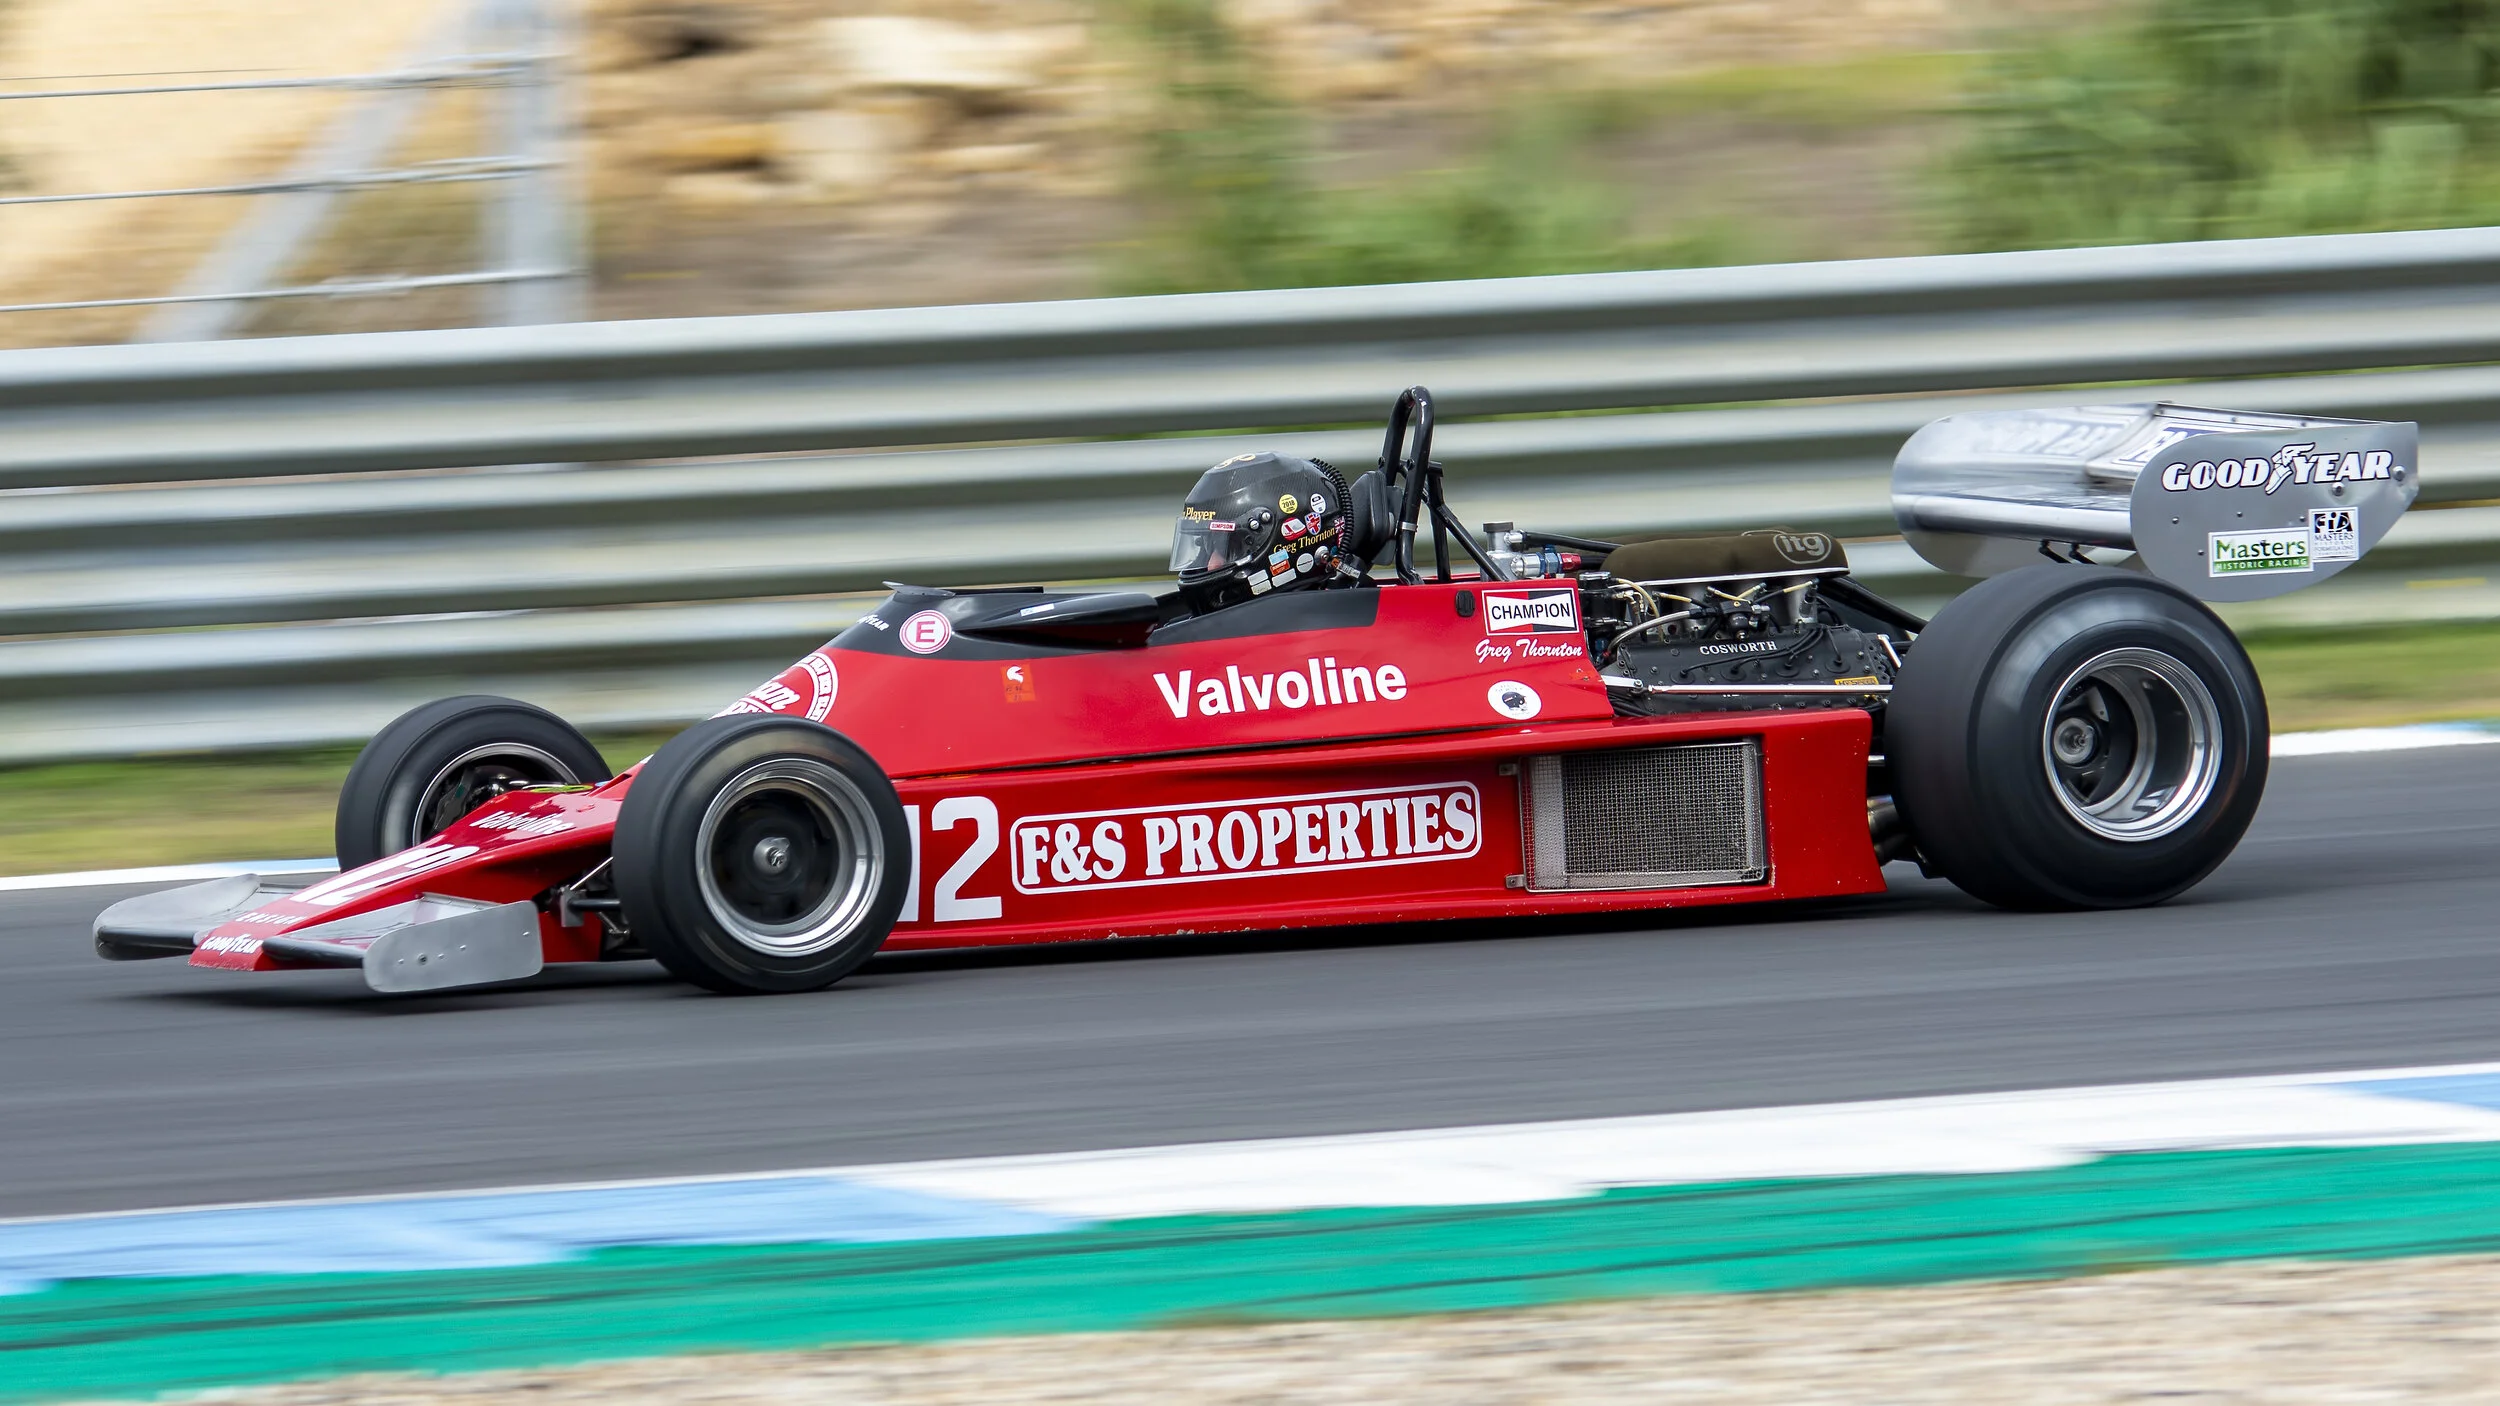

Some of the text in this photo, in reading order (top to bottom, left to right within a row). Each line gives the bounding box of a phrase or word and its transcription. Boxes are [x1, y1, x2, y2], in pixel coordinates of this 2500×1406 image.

[2161, 446, 2393, 492] GOODYEAR
[1185, 507, 1216, 523] Player
[1273, 527, 1336, 554] Greg Thornton
[1780, 535, 1826, 556] itg
[2216, 539, 2306, 560] Masters
[2216, 558, 2307, 571] HISTORIC RACING
[1491, 602, 1571, 620] CHAMPION
[915, 620, 936, 643] E
[1475, 638, 1583, 664] Greg Thornton
[1699, 640, 1778, 655] COSWORTH
[1153, 656, 1408, 719] Valvoline
[469, 810, 575, 834] Valvoline
[1018, 821, 1127, 886] F&S
[1143, 791, 1476, 877] PROPERTIES
[288, 844, 480, 906] 12
